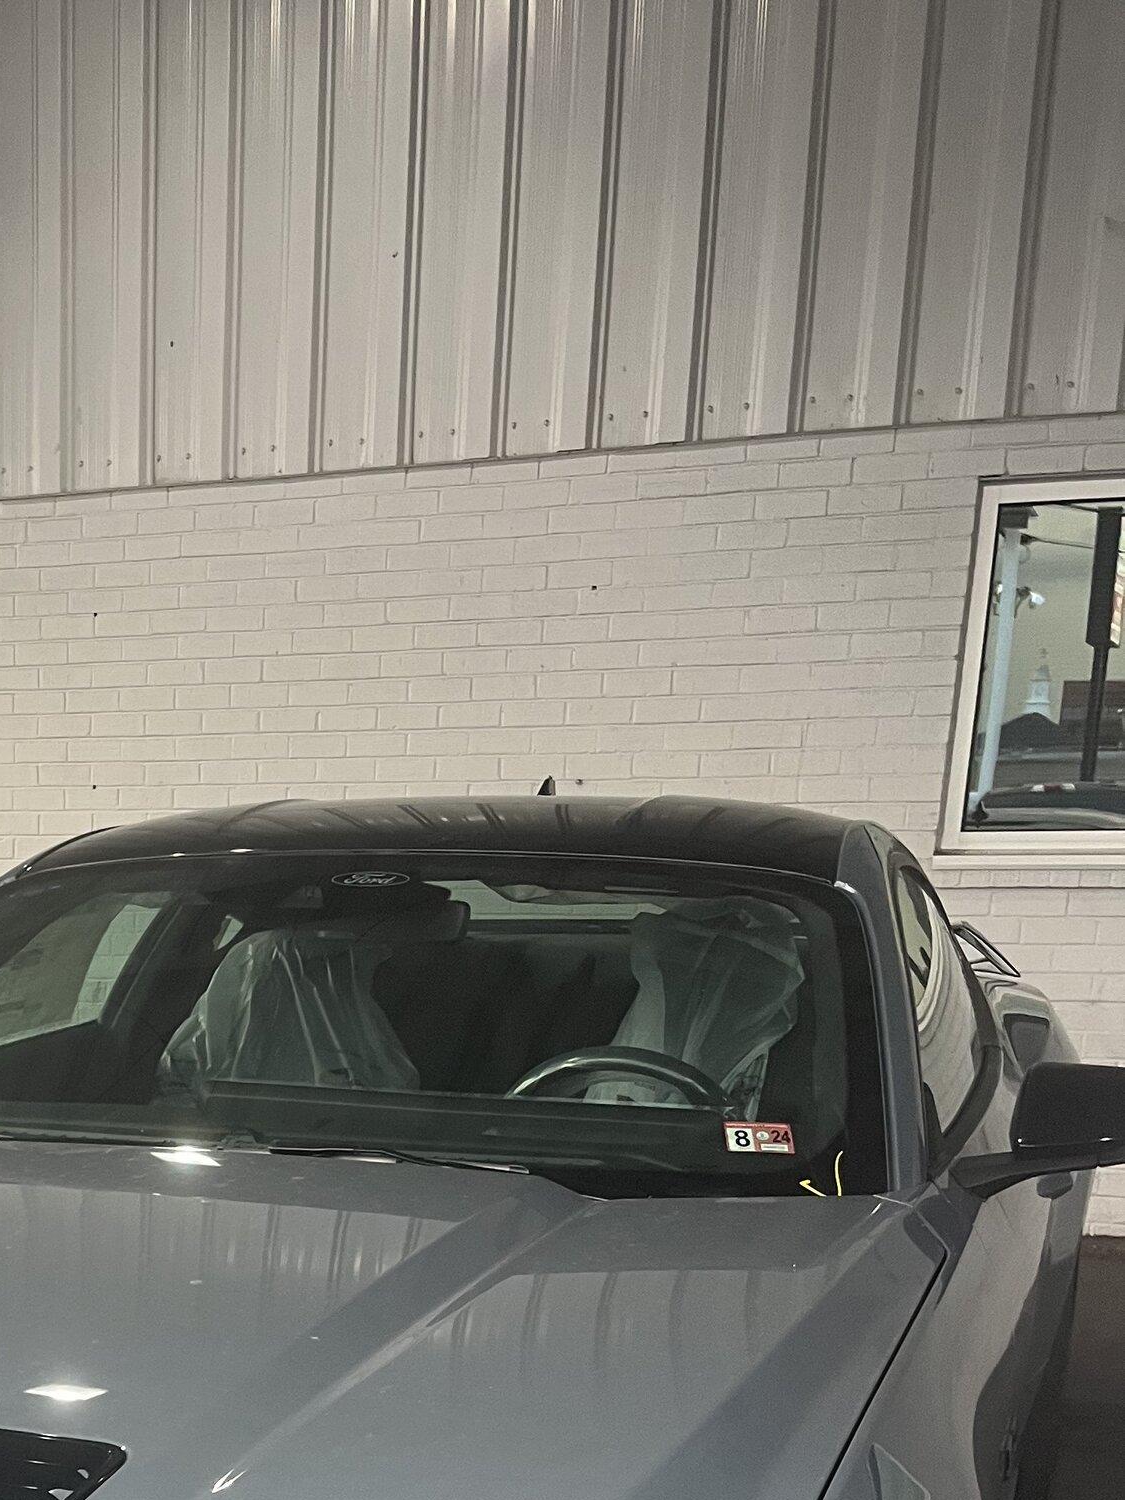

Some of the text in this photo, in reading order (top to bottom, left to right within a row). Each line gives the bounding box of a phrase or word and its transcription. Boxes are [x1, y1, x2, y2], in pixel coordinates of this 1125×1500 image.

[343, 873, 397, 884] Ford
[734, 1130, 791, 1147] 8 24
